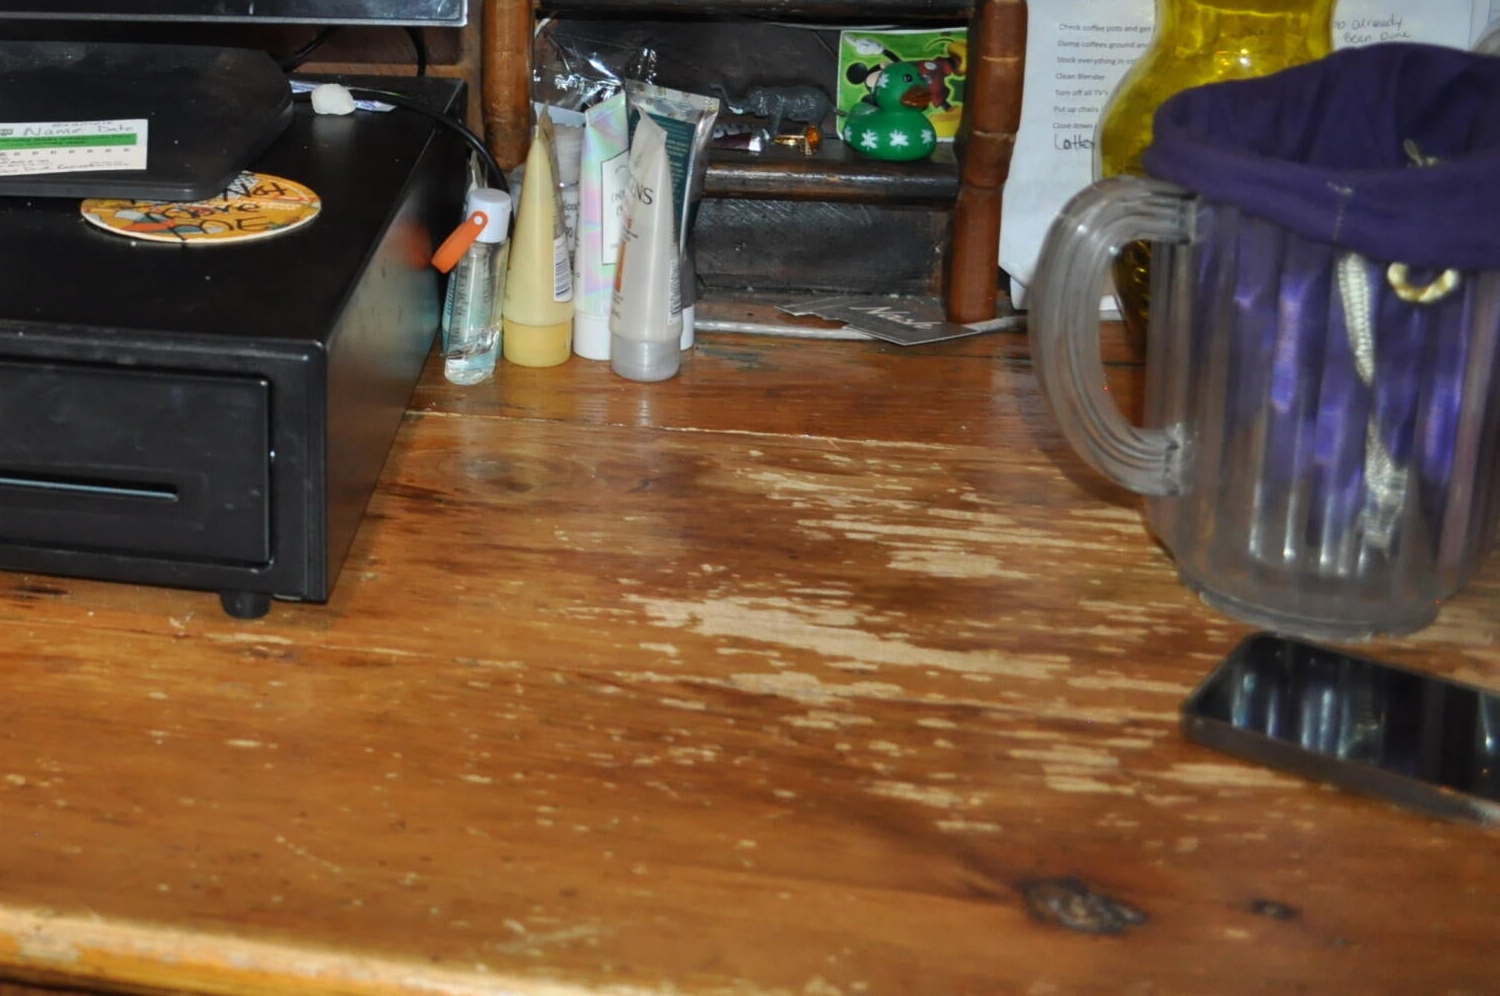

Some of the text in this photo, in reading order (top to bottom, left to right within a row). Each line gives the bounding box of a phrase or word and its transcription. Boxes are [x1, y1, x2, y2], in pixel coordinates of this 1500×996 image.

[1108, 41, 1135, 49] ground
[1077, 57, 1116, 65] everything
[1053, 105, 1099, 113] Put chairs
